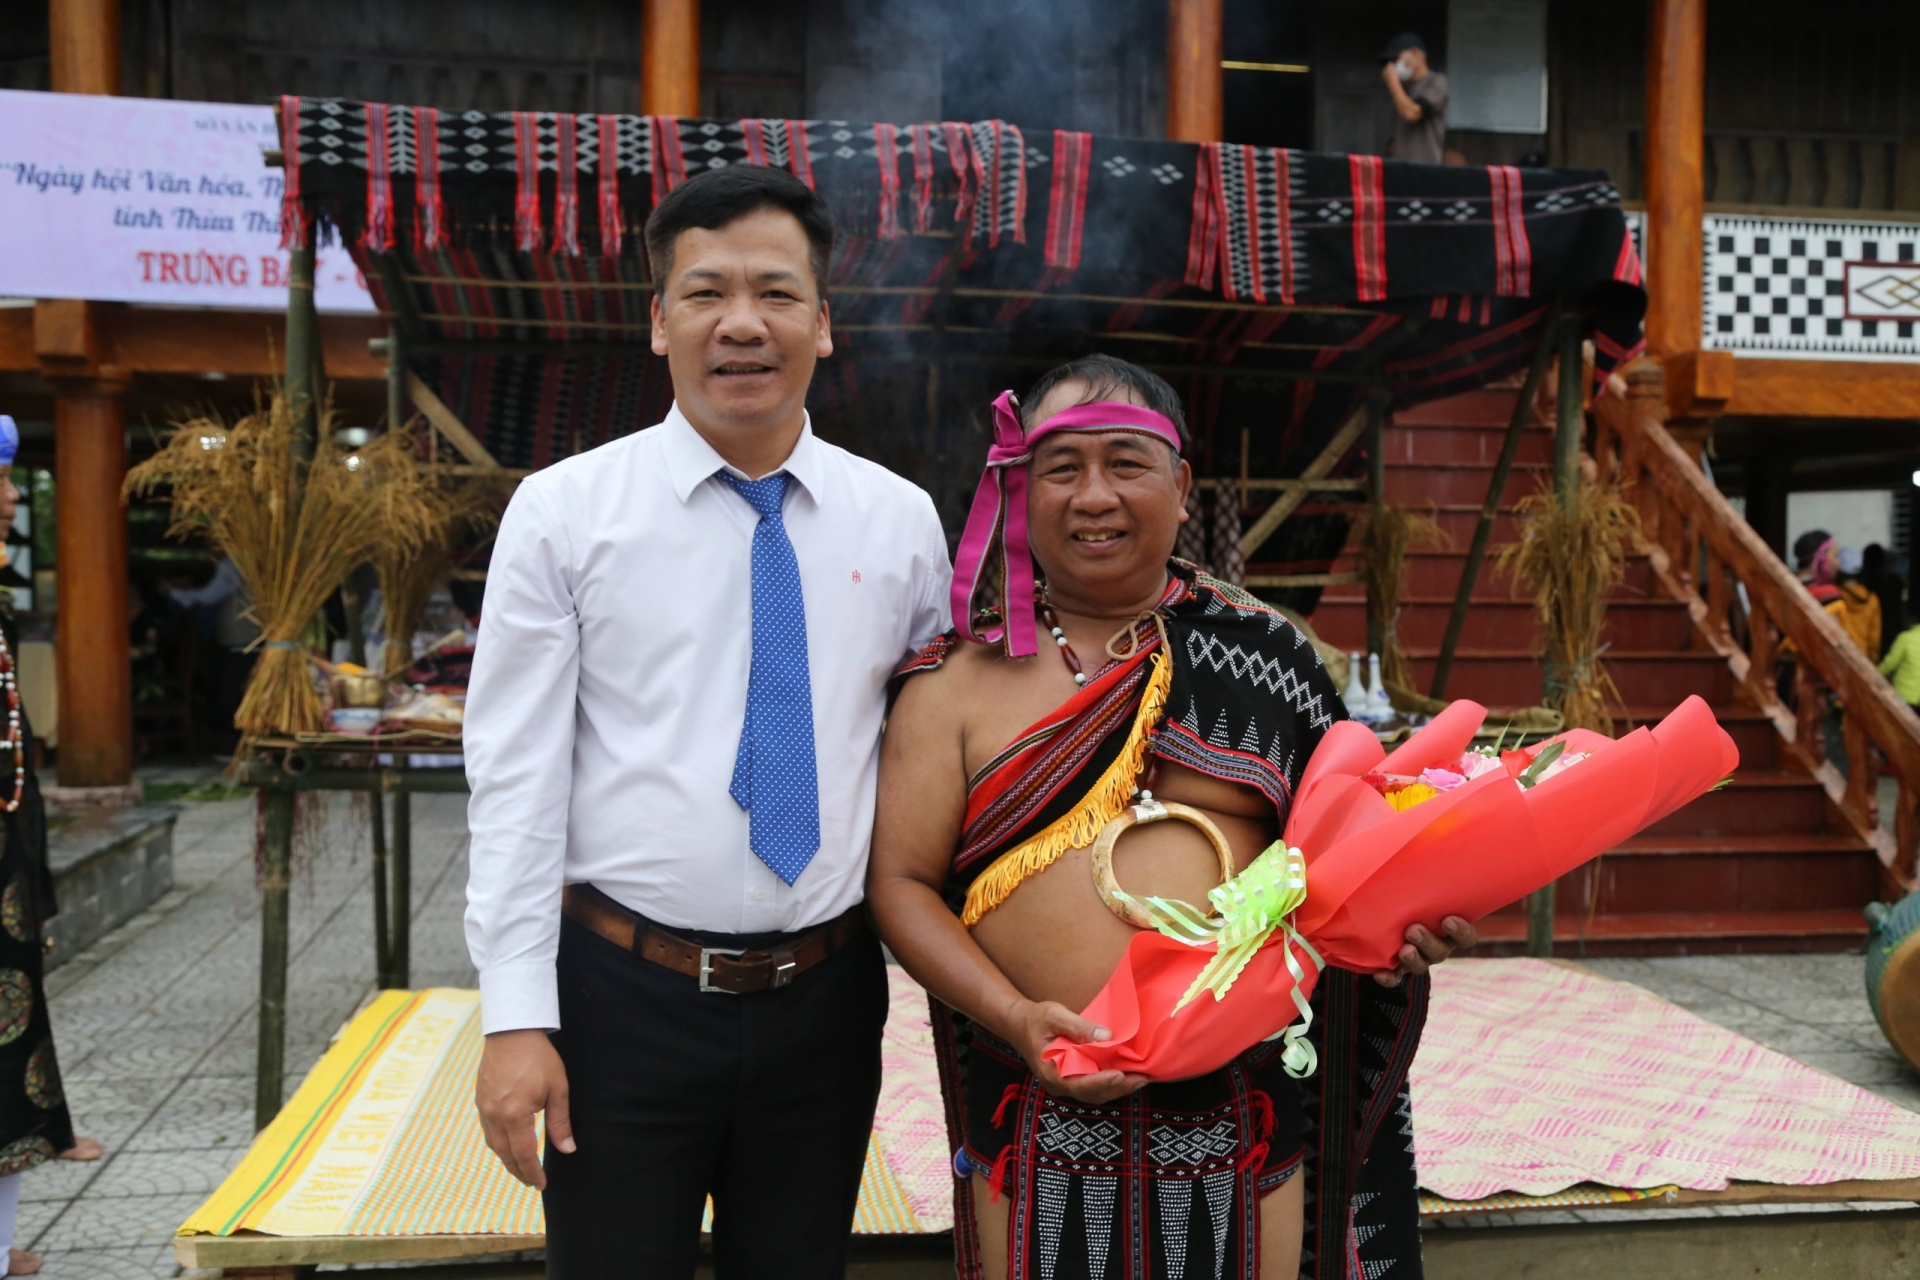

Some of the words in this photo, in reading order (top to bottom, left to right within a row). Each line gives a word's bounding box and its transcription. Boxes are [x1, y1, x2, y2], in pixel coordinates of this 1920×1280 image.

[139, 170, 191, 194] Văn
[329, 1110, 400, 1156] VIET
[286, 1164, 371, 1212] NAM
